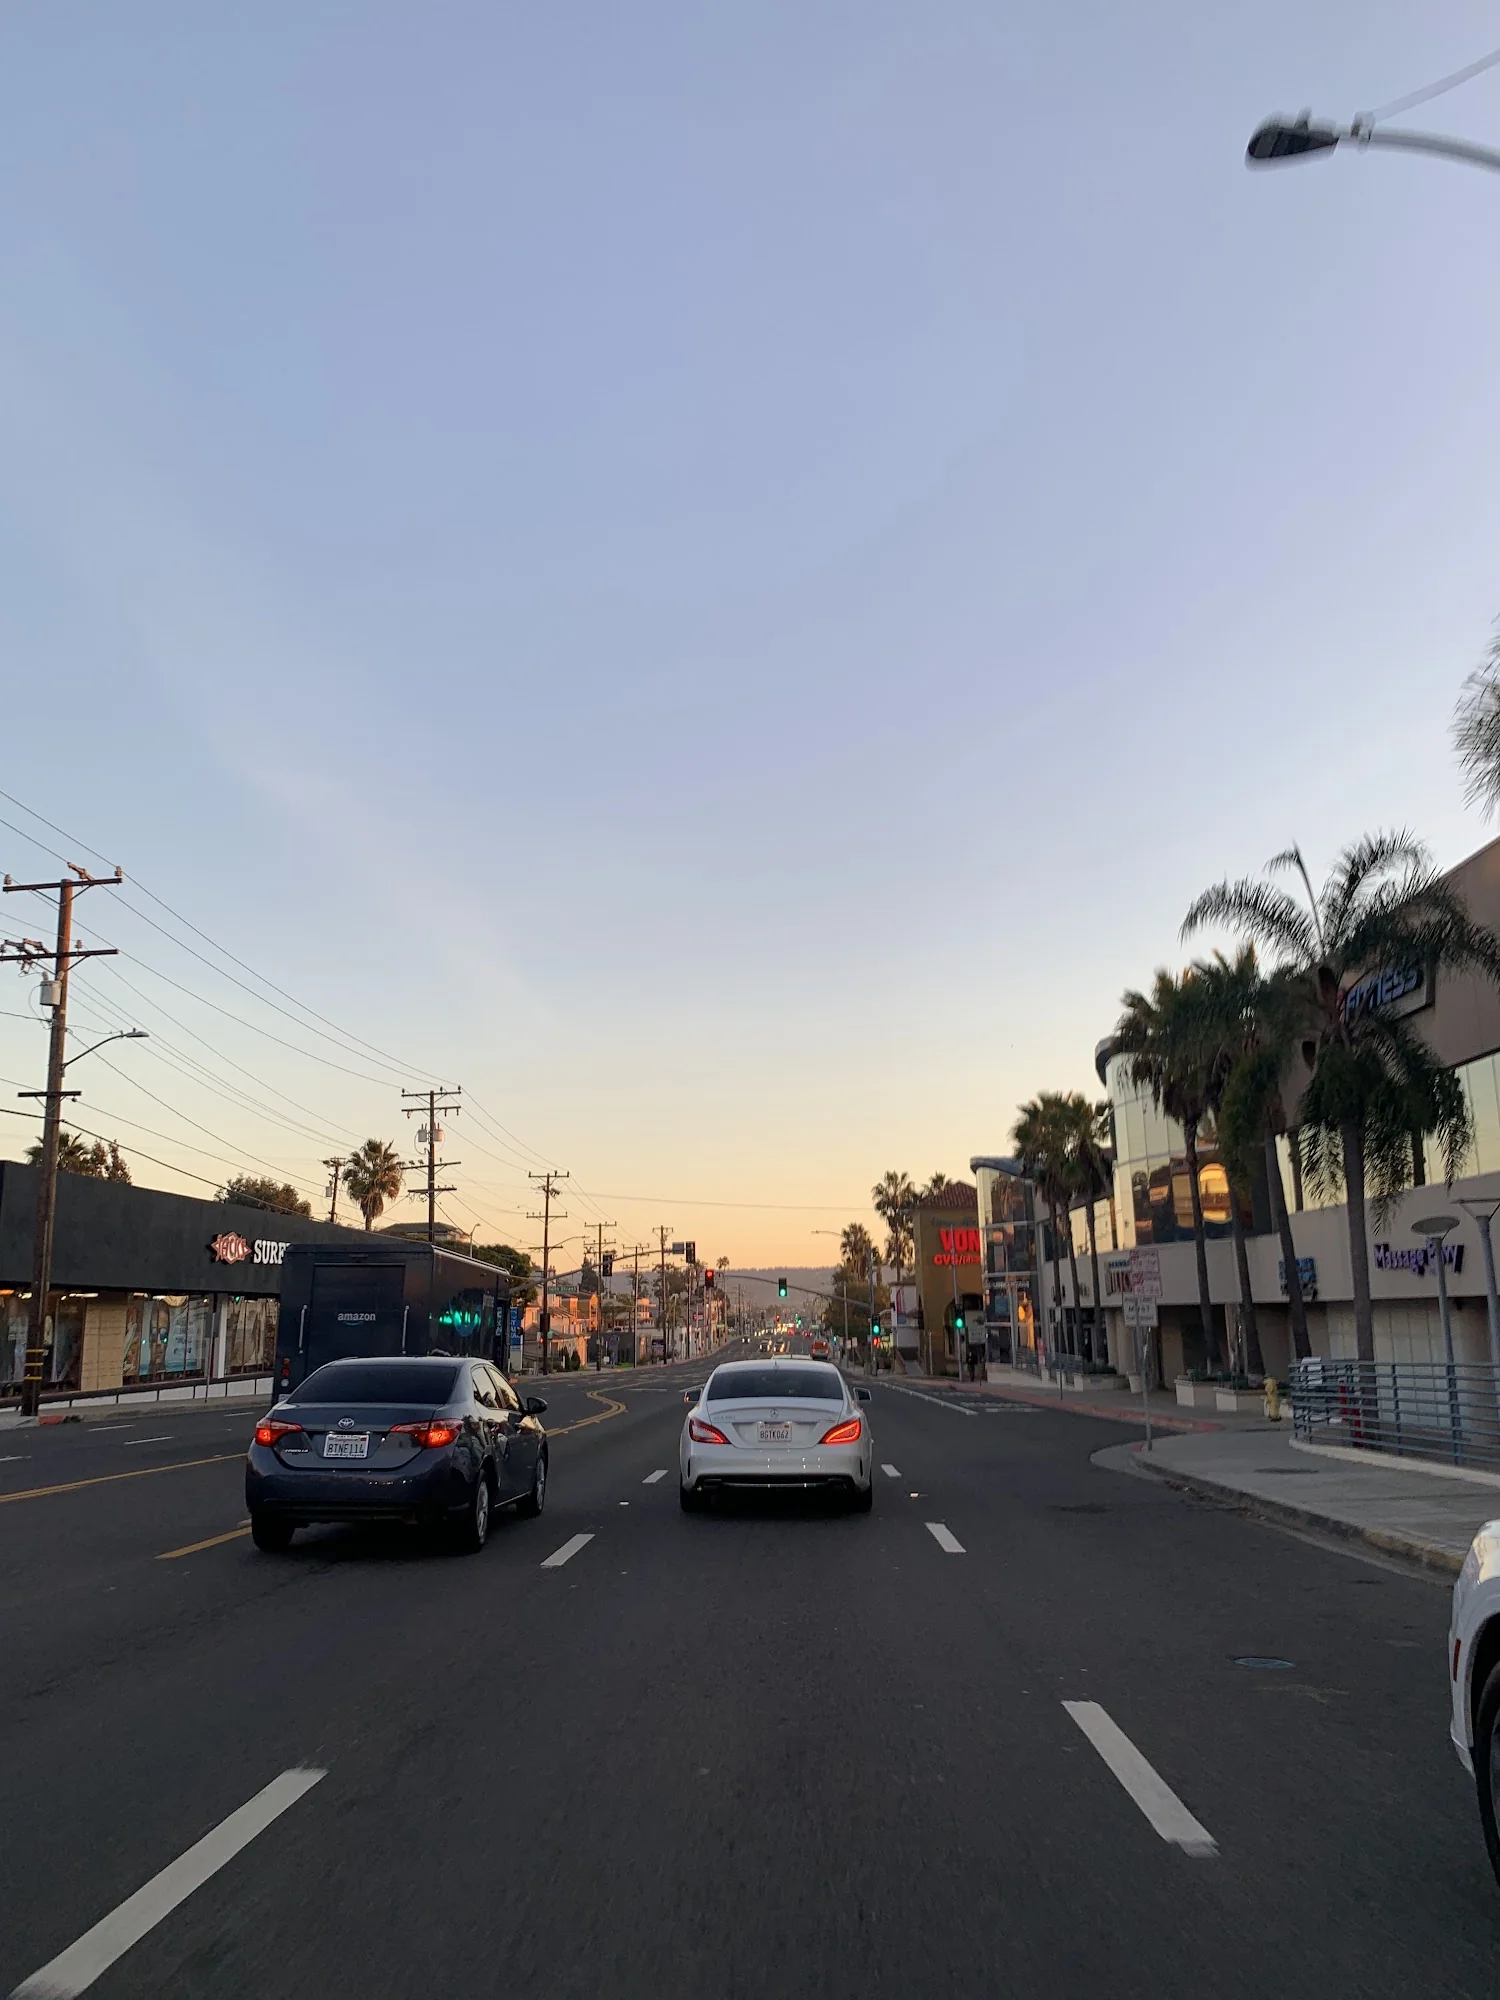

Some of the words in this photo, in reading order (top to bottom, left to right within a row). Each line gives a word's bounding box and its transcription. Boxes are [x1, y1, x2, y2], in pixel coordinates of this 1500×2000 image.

[1373, 1244, 1425, 1276] Massage
[337, 1312, 376, 1321] amazon
[327, 1443, 365, 1454] 8TNE114
